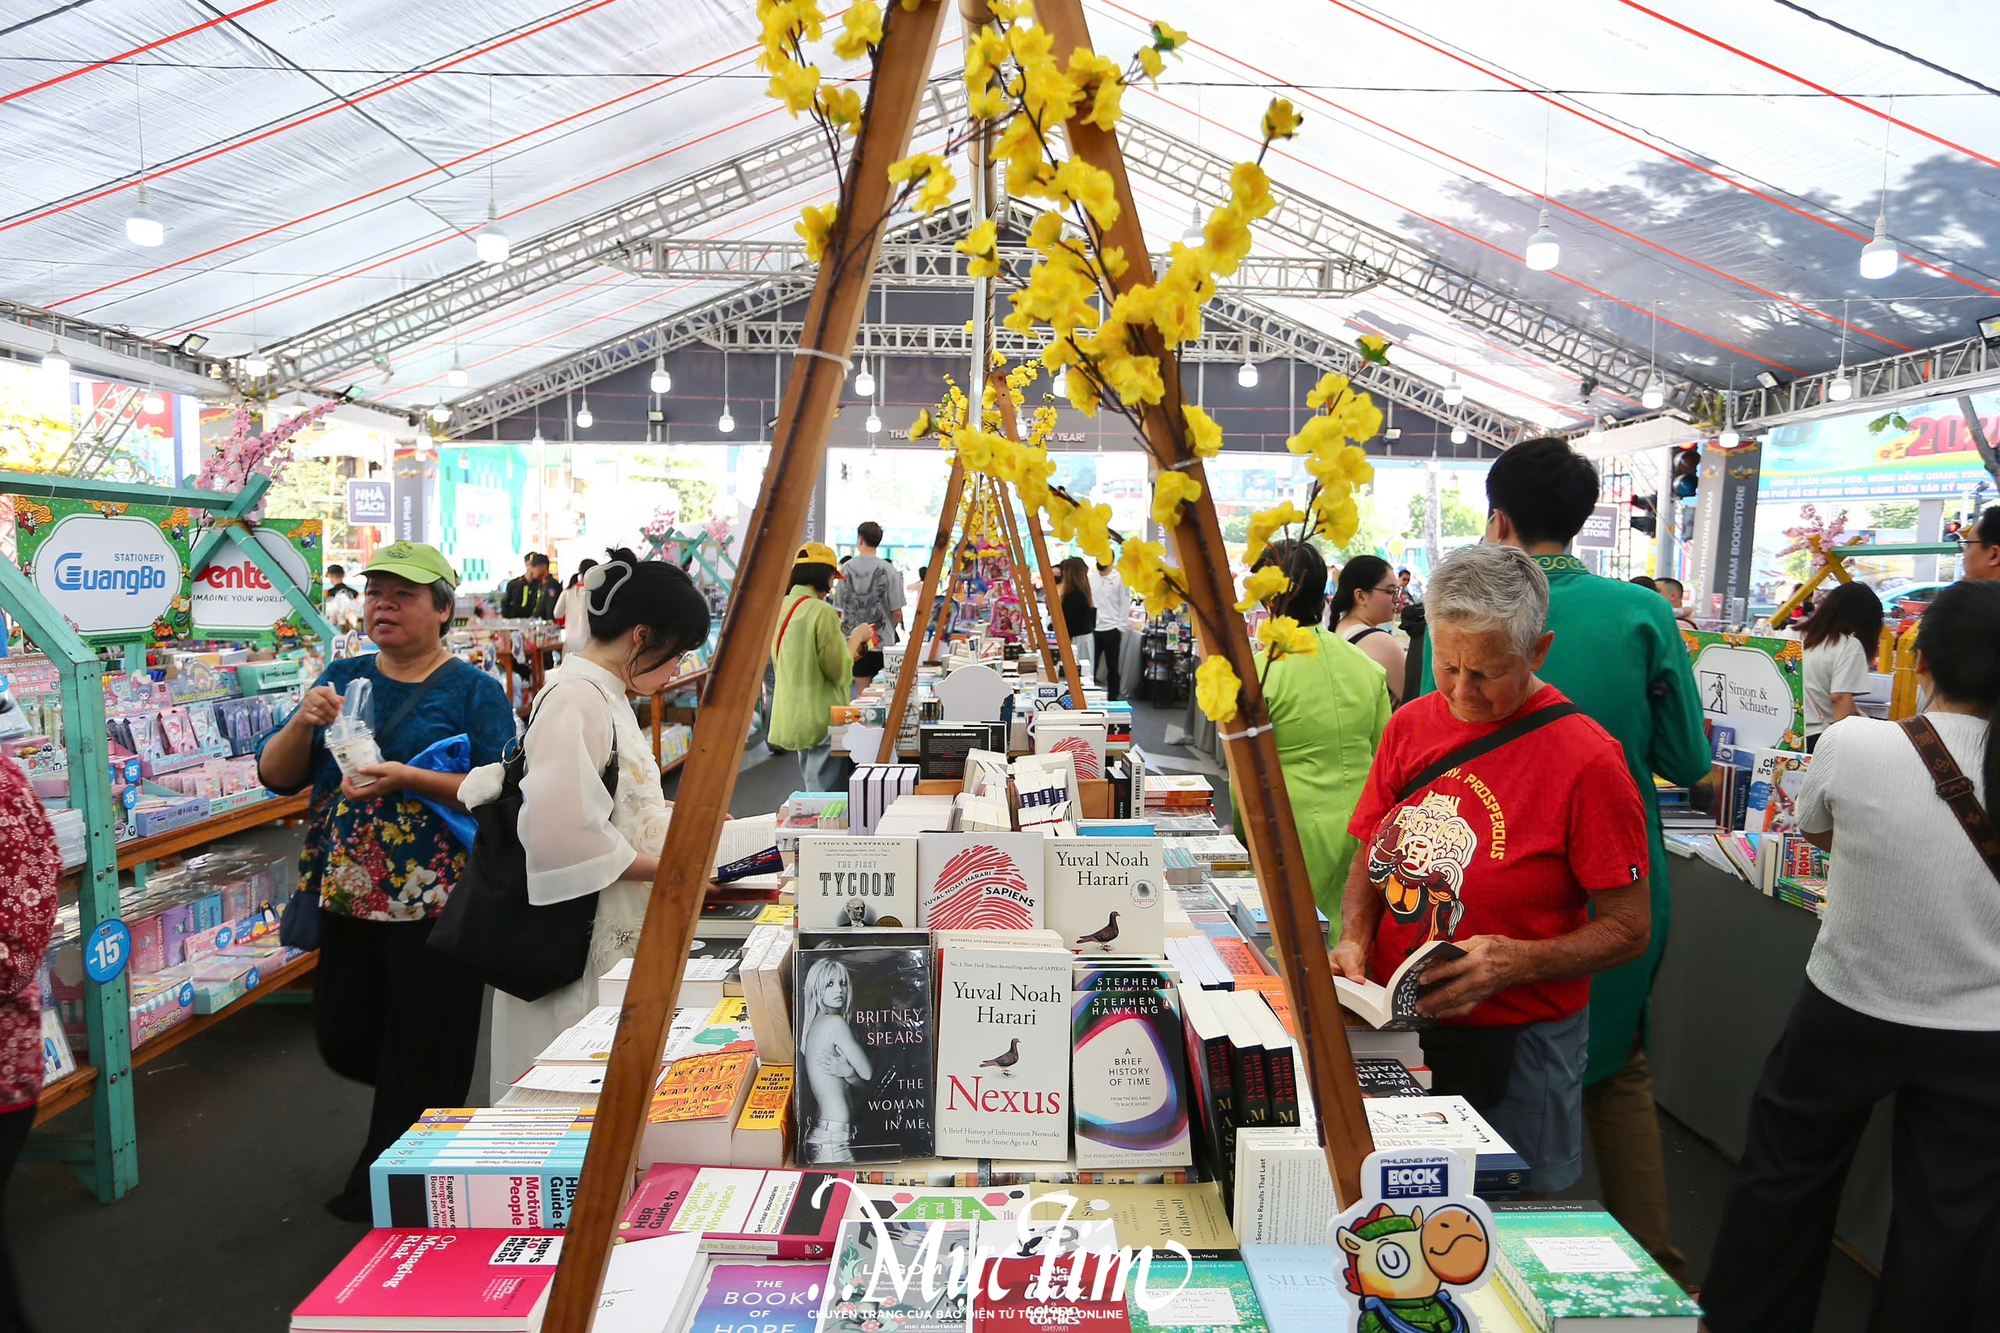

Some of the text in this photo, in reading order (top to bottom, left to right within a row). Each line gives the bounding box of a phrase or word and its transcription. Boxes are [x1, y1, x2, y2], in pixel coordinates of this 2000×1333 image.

[1057, 432, 1086, 442] YEAR!
[354, 486, 385, 500] NHÀ
[1704, 491, 1714, 517] NAM
[1582, 529, 1610, 538] STORE
[1728, 485, 1746, 584] NAM BOOKSTORE
[114, 553, 164, 562] STATIONERY
[54, 552, 166, 595] GuangBo
[1728, 680, 1768, 700] Simon &
[1740, 696, 1778, 716] Schuster
[1736, 784, 1746, 820] Mermaids
[1464, 773, 1506, 860] PROSPEROUS
[838, 860, 878, 868] THE FIRST
[1056, 850, 1150, 866] Yuval Noah
[820, 872, 896, 896] TYCOON
[923, 871, 992, 907] YUVAL NOAH HARARI
[1077, 870, 1129, 886] Harari
[986, 886, 1035, 908] SAPIENS
[953, 981, 1061, 1003] Yuval Noah
[1097, 978, 1158, 986] STEPHEN
[1092, 1006, 1158, 1015] HAWKING
[1094, 997, 1156, 1006] STEPHEN
[856, 1008, 922, 1024] BRITNEY
[977, 1006, 1036, 1025] Harari
[867, 1030, 923, 1046] SPEARS
[674, 1064, 738, 1076] WEALTH
[1209, 1046, 1222, 1092] GREENE
[1218, 1044, 1232, 1088] ROBERT
[1253, 1054, 1266, 1100] ROBERT
[660, 1083, 733, 1096] NATIONS
[898, 1079, 924, 1090] THE
[1244, 1056, 1256, 1102] GREENE
[1271, 1057, 1284, 1105] GREENE
[1281, 1056, 1294, 1102] ROBERT
[868, 1098, 925, 1111] WOMAN
[946, 1074, 1060, 1115] Nexus
[885, 1118, 925, 1130] IN ME
[964, 1128, 986, 1136] History
[1388, 1168, 1440, 1185] BOOK
[508, 1176, 524, 1225] People
[550, 1176, 564, 1219] Guide
[1388, 1185, 1441, 1195] STORE
[648, 1190, 679, 1229] Guide to
[673, 1182, 710, 1230] Navigating
[688, 1191, 718, 1230] the Toxic
[704, 1184, 736, 1230] Workplace
[754, 1186, 779, 1233] Set boundaries
[633, 1207, 655, 1229] HBR
[771, 1216, 782, 1233] Choose
[1154, 1199, 1172, 1236] Malcolm
[1172, 1198, 1191, 1237] Gladwell
[390, 1235, 422, 1259] Risk
[434, 1235, 456, 1250] On
[494, 1237, 515, 1263] READS
[506, 1237, 530, 1262] MUST
[527, 1238, 540, 1249] 10
[529, 1237, 553, 1263] HBR'S
[739, 1243, 775, 1251] Workplace
[382, 1235, 441, 1288] Managing
[1267, 1274, 1334, 1286] SILEN
[723, 1292, 807, 1305] BOOK
